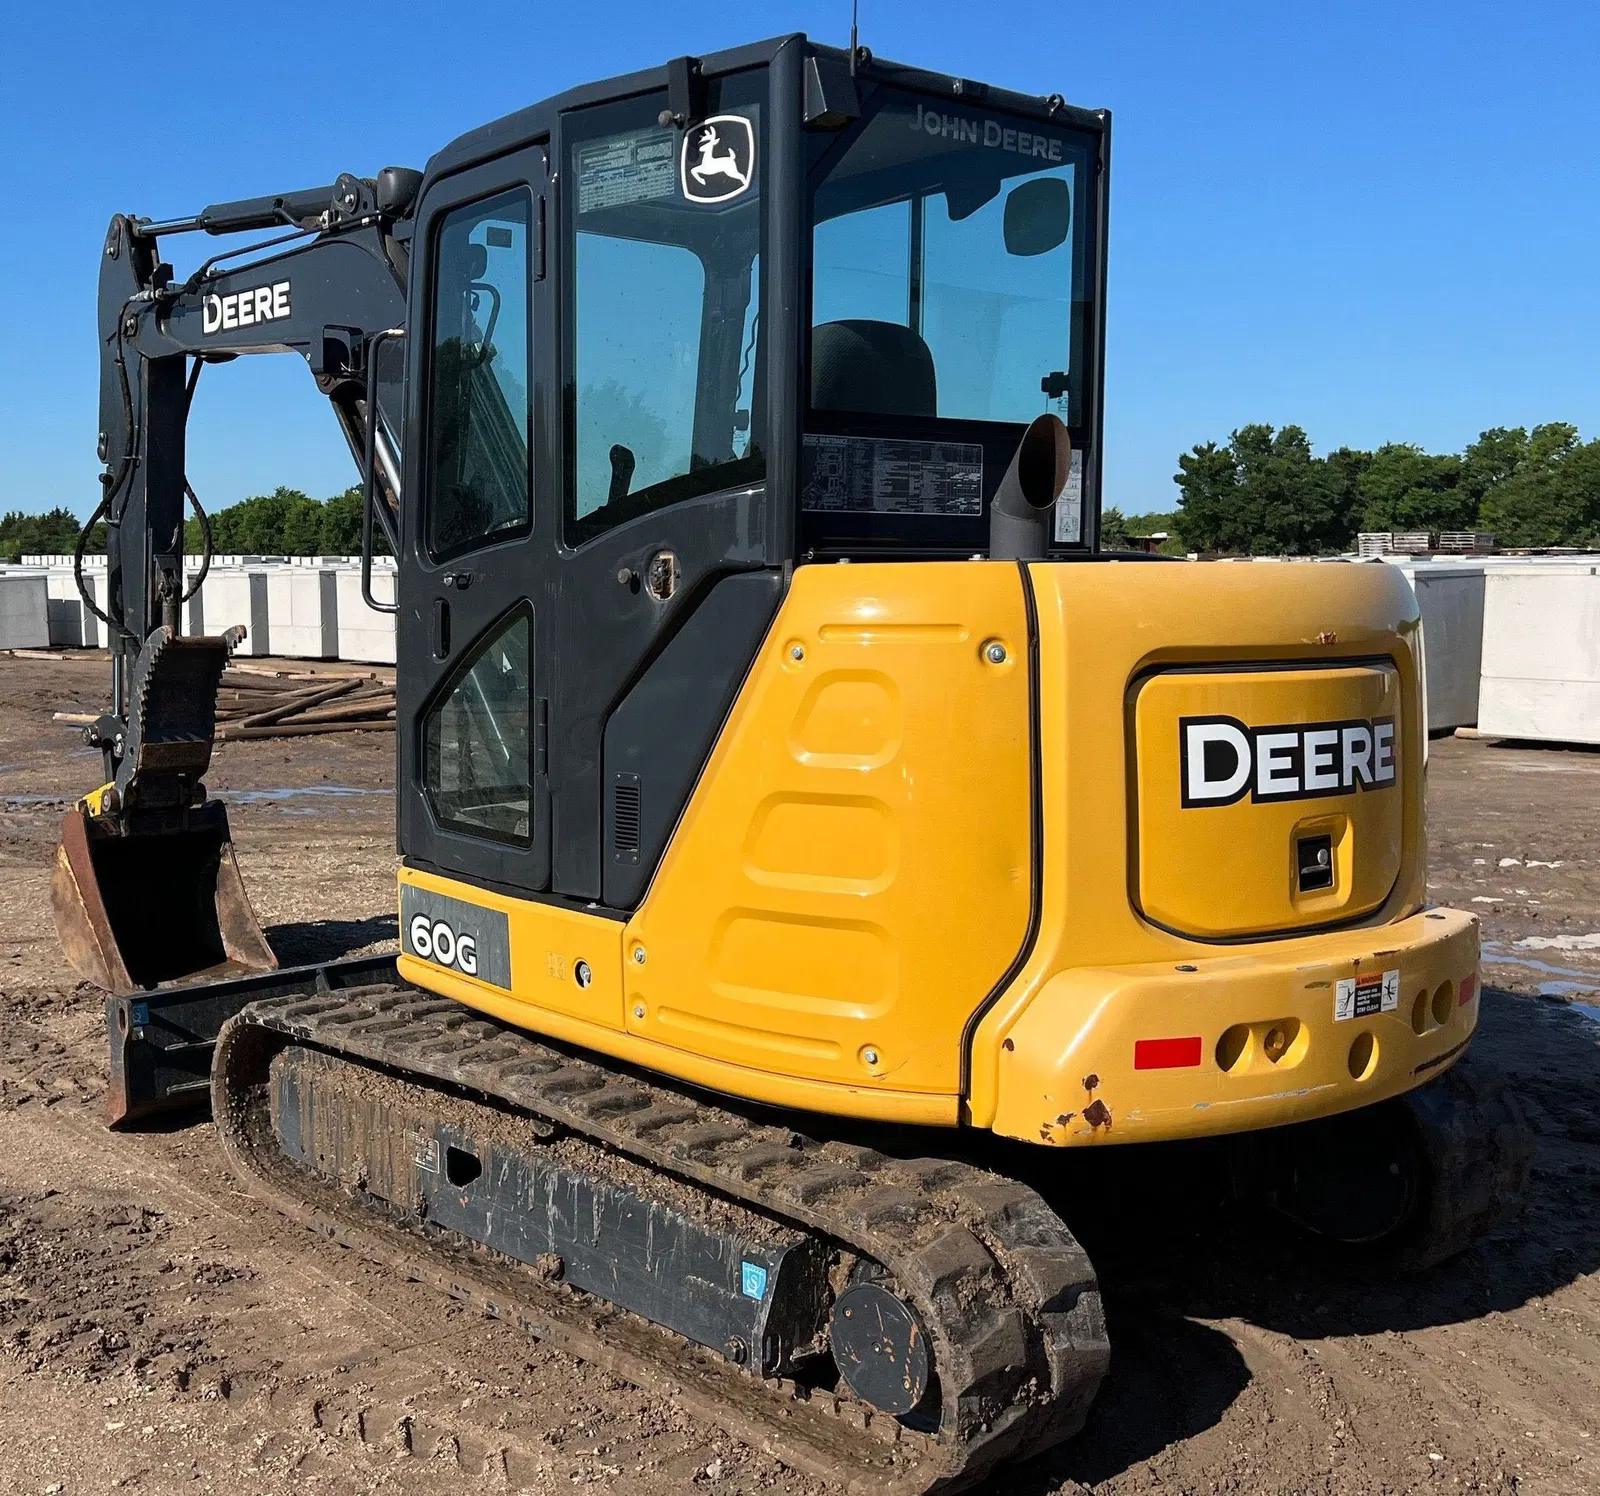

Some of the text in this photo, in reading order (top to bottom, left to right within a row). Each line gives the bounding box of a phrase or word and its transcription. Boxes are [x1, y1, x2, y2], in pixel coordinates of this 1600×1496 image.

[909, 104, 1063, 162] JOHN DEERE
[202, 281, 291, 335] DEERE
[1186, 723, 1395, 800] DEERE
[409, 914, 478, 976] 60G
